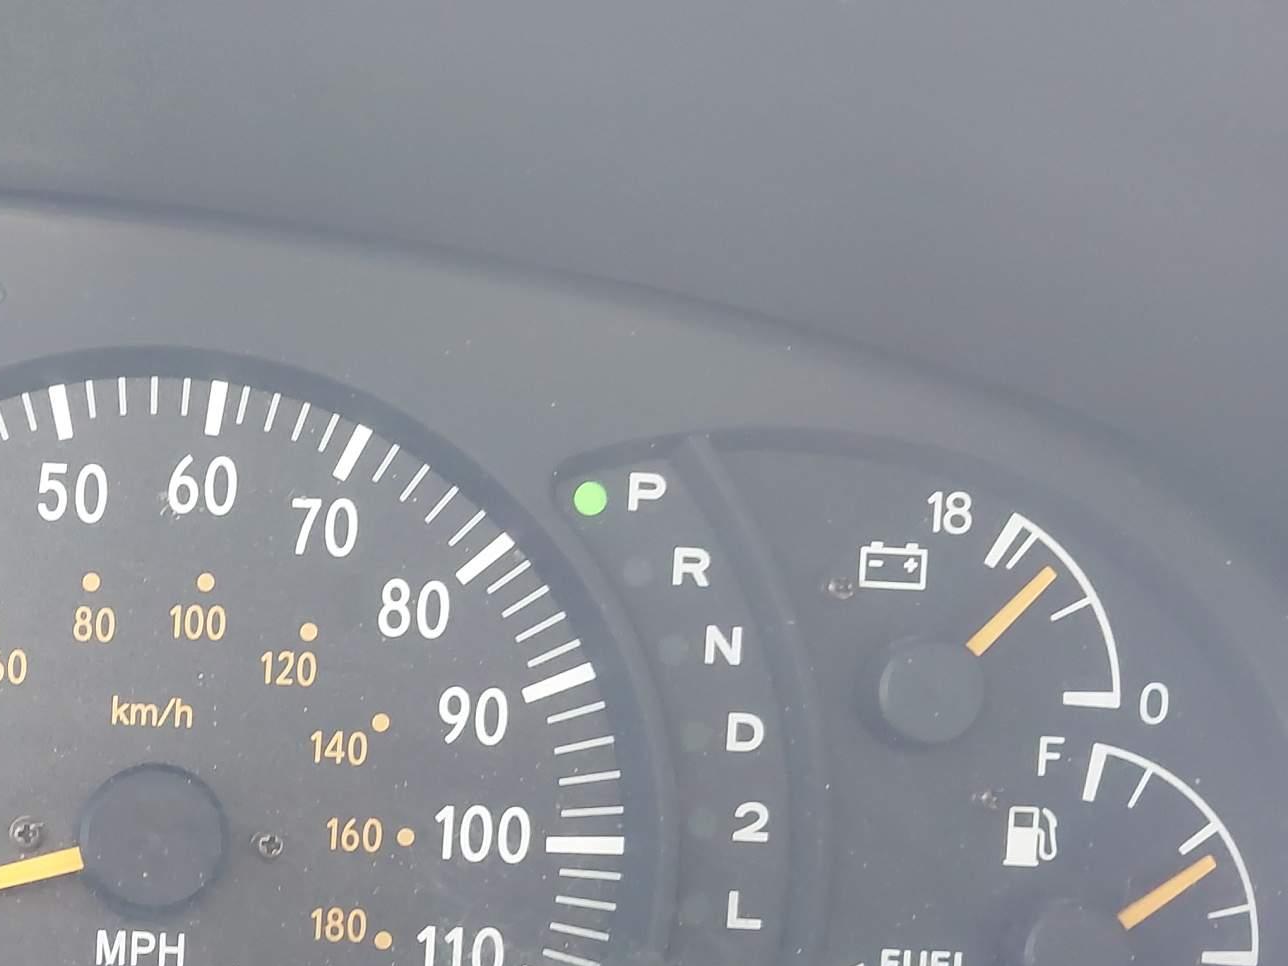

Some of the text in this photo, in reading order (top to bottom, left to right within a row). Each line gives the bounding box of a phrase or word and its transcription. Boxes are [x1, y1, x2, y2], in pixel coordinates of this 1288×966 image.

[37, 462, 108, 524] 50
[167, 454, 238, 516] 60
[627, 472, 667, 511] P
[291, 497, 358, 558] 70
[927, 491, 972, 535] 18
[672, 546, 711, 587] R
[73, 606, 115, 643] 80
[169, 604, 226, 641] 100
[378, 578, 450, 639] 80
[704, 624, 743, 666] N
[261, 650, 317, 687] 120
[111, 695, 193, 728] km/h
[438, 686, 508, 746] 90
[1139, 682, 1169, 725] 0
[310, 730, 368, 766] 140
[726, 712, 765, 752] D
[1037, 735, 1066, 777] F
[326, 817, 383, 853] 160
[434, 804, 531, 864] 100
[732, 801, 769, 843] 2
[311, 907, 367, 943] 180
[726, 890, 762, 930] L
